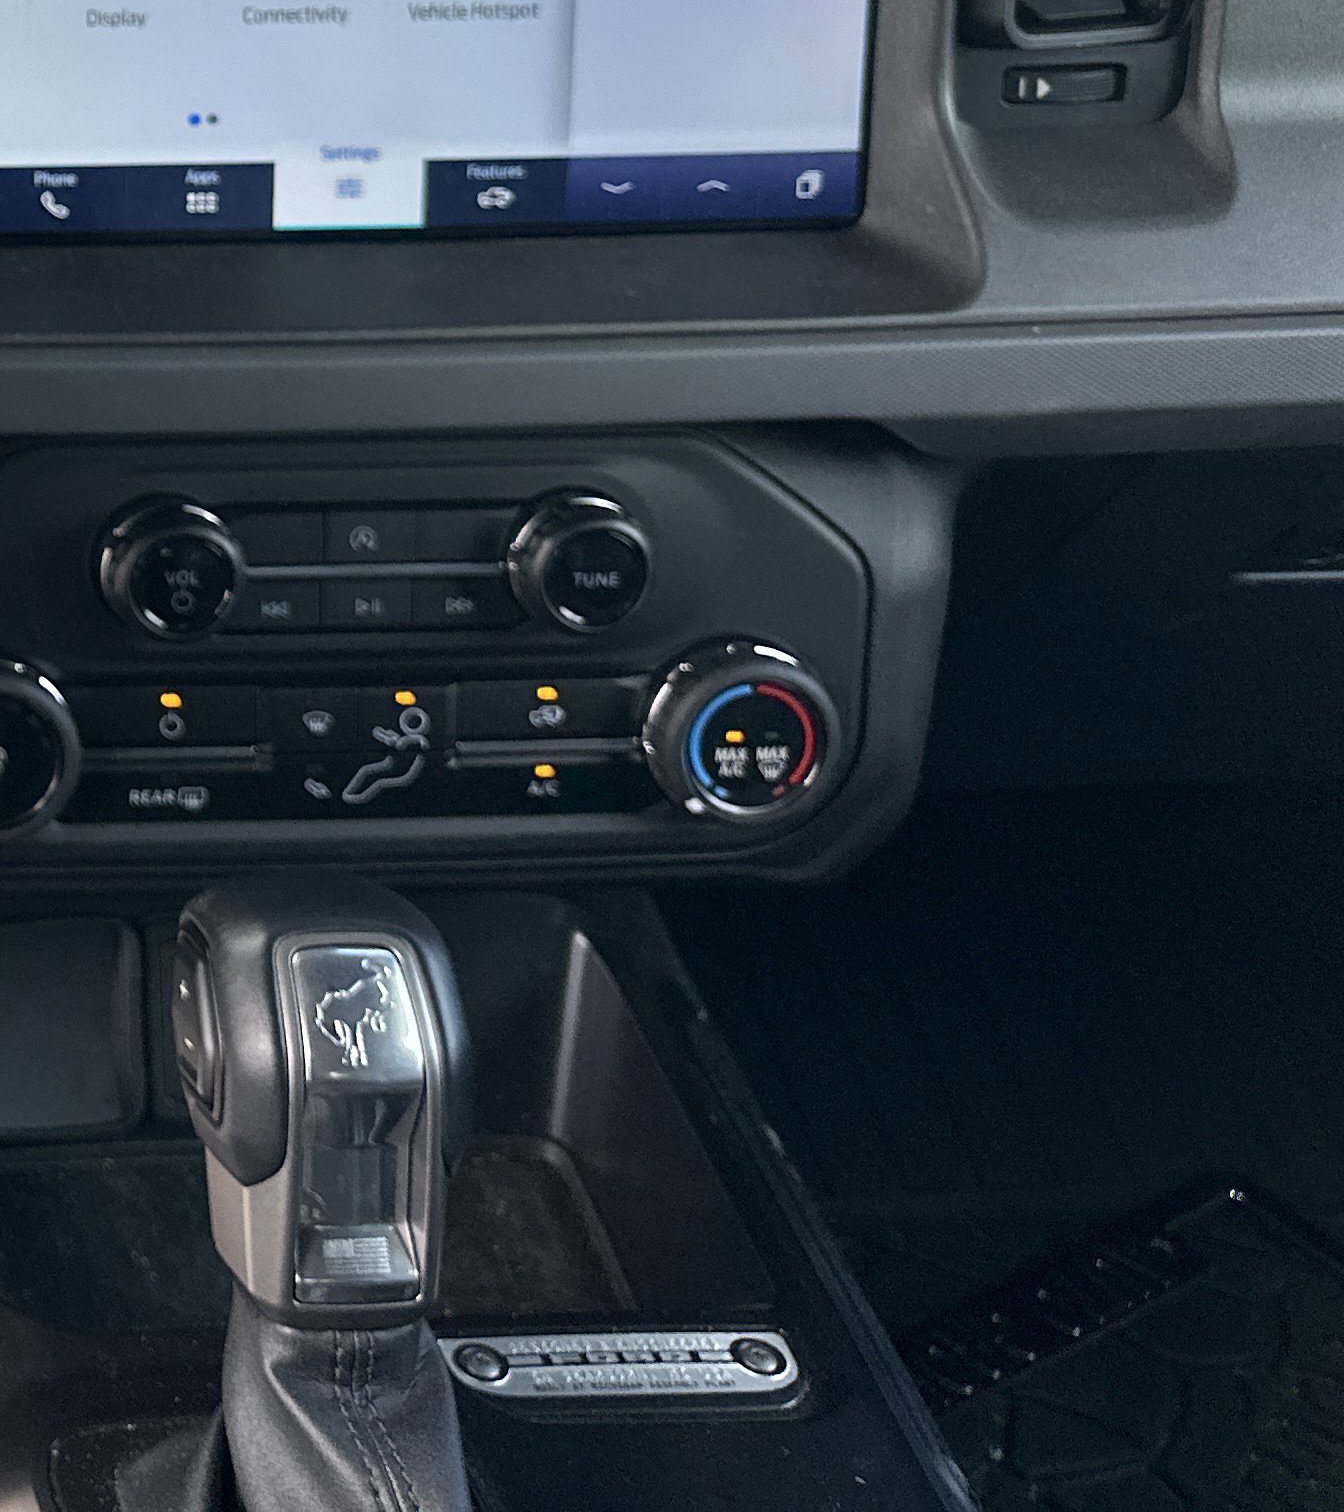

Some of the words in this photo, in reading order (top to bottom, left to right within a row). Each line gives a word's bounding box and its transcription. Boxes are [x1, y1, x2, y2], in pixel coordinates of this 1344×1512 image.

[86, 8, 146, 29] Display
[242, 5, 348, 27] Connectivity
[408, 2, 468, 22] Vehicle
[470, 1, 540, 21] Hotspot
[320, 144, 381, 163] Settings
[33, 170, 79, 188] Phone
[466, 163, 529, 181] Features
[163, 569, 200, 588] VOL
[572, 570, 622, 589] TUNE
[714, 746, 750, 763] MAX
[755, 745, 791, 761] MAX
[717, 761, 747, 779] A/C
[128, 788, 177, 808] REAR
[526, 779, 561, 799] A/C
